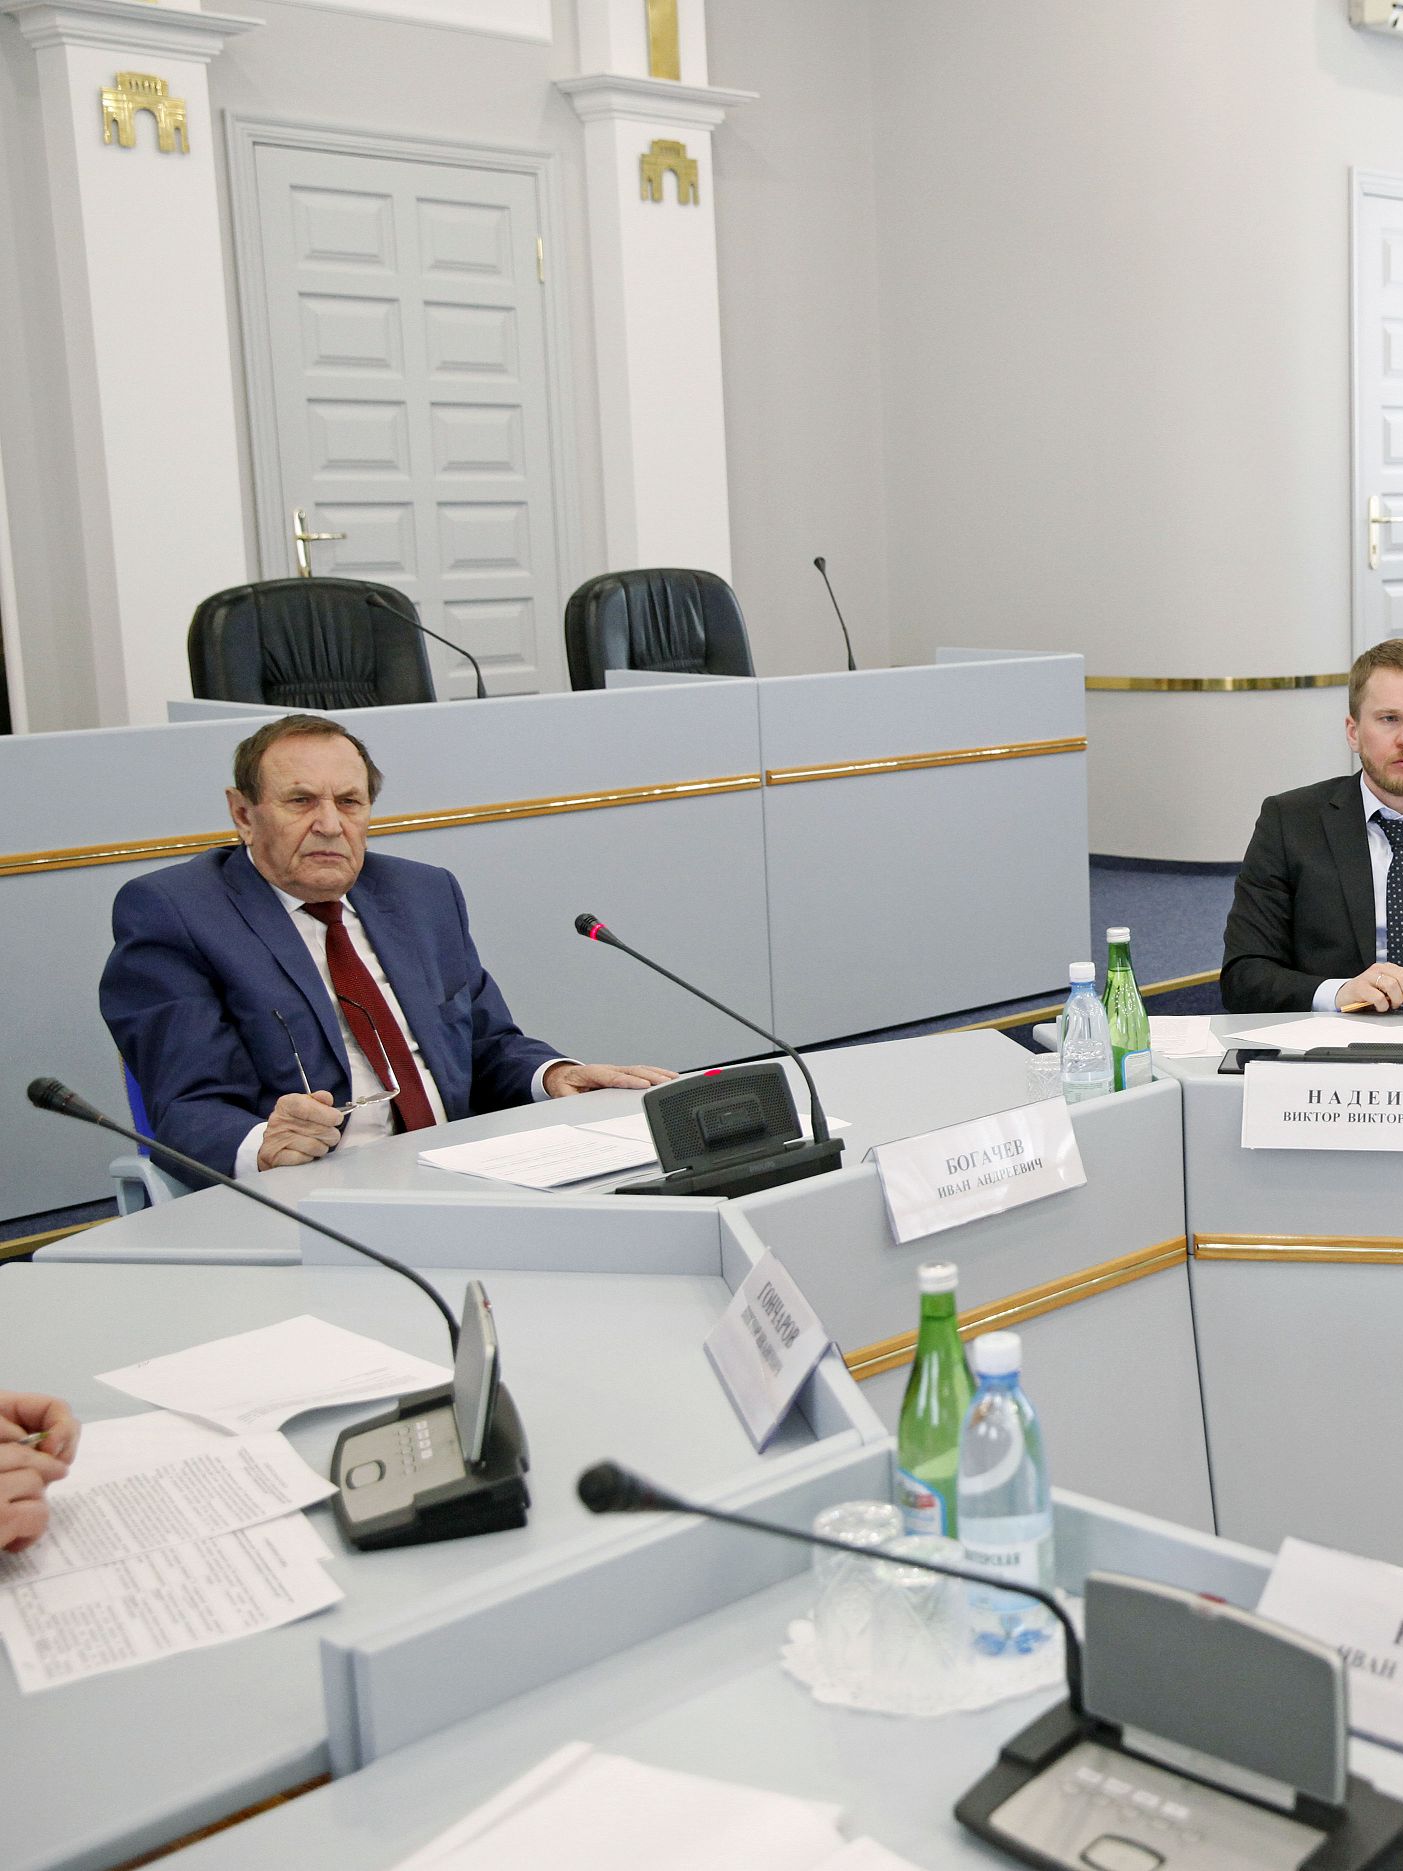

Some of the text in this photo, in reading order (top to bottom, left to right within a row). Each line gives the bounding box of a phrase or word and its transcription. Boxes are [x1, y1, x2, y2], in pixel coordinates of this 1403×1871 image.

[1283, 1111, 1341, 1123] ВИКТОР
[945, 1138, 1025, 1175] БОГАЧЕВ
[937, 1157, 1043, 1199] ИВАН АНДРЕЕВИЧ
[757, 1281, 800, 1349] ГОНЧАРОВ
